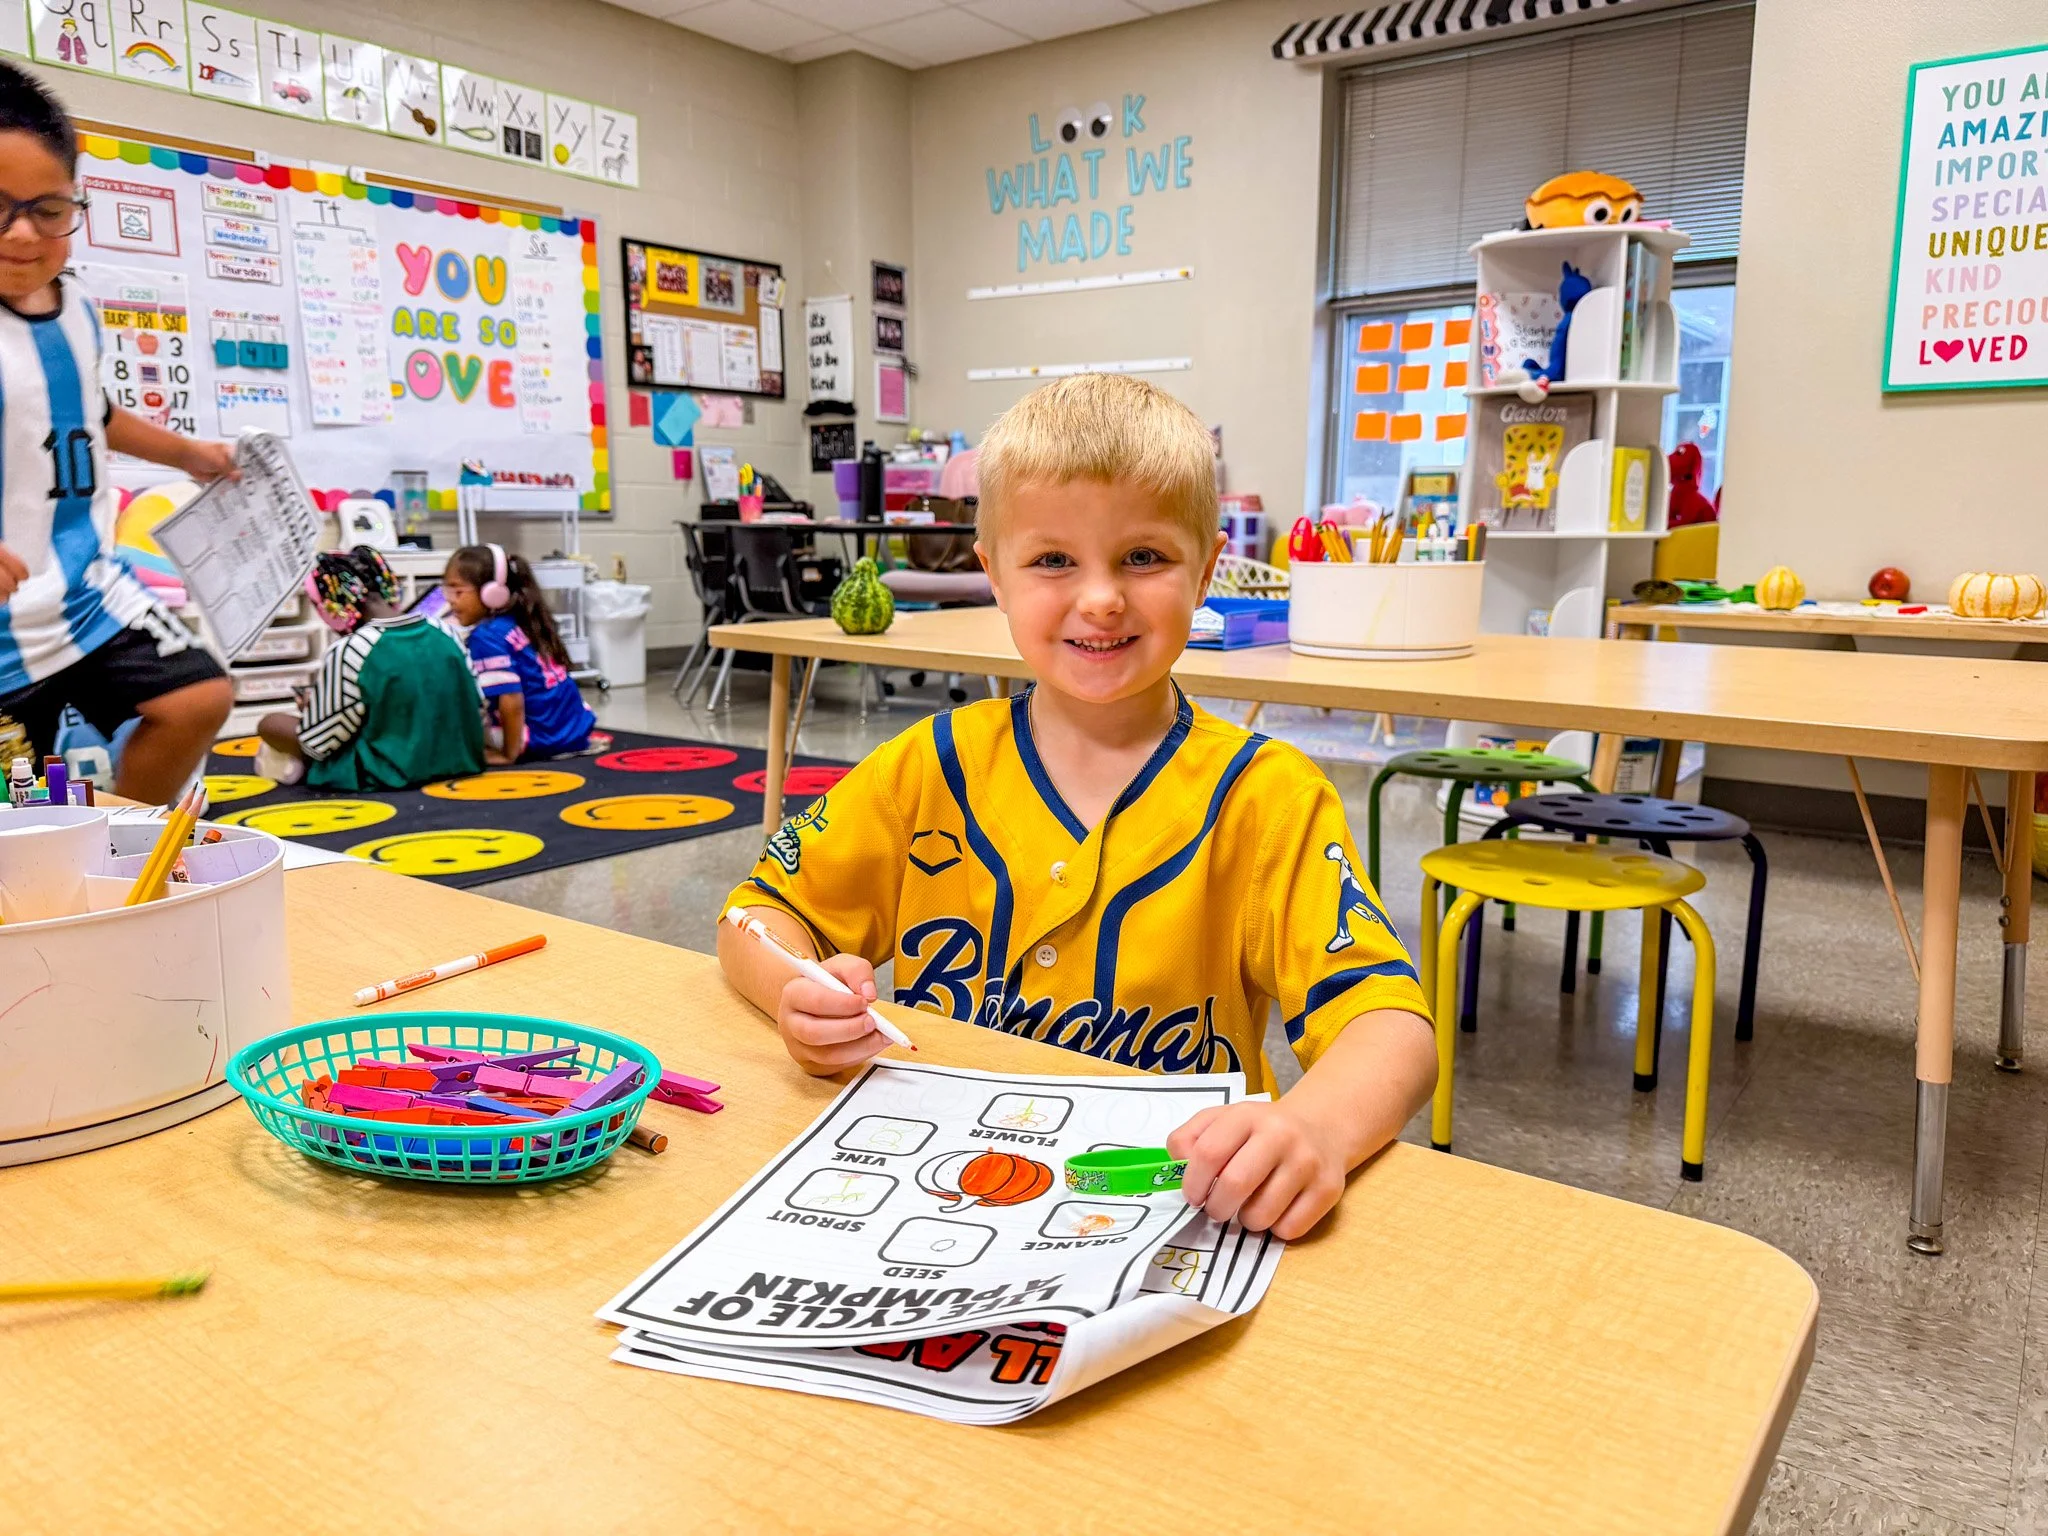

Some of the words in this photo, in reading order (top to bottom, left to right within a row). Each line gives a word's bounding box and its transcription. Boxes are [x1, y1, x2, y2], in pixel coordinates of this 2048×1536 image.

[1942, 77, 2006, 112] YOU
[986, 149, 1106, 214] WHAT
[1125, 136, 1193, 196] WE
[1935, 149, 2048, 186] IMPOR
[1017, 204, 1135, 273] MADE
[1928, 223, 2048, 259] UNIQUE
[395, 241, 507, 306] YOU
[1925, 263, 2002, 295] KIND
[392, 306, 460, 343] ARE
[479, 316, 518, 347] SO
[169, 336, 183, 357] 3
[114, 360, 129, 380] 8
[168, 364, 190, 385] 10
[117, 388, 137, 408] 15
[172, 391, 189, 410] 17
[1500, 402, 1568, 424] Gaston
[42, 428, 96, 499] 10
[969, 1128, 1059, 1148] FLOWER
[831, 1151, 887, 1168] VINE
[766, 1211, 863, 1234] SPROUT
[1021, 1236, 1128, 1253] ORANGE
[883, 1265, 944, 1280] SEED
[735, 1271, 1007, 1308] PUMPKIN
[937, 1282, 1062, 1322] LIFE
[673, 1290, 754, 1323] OF
[757, 1297, 931, 1329] CYCLE
